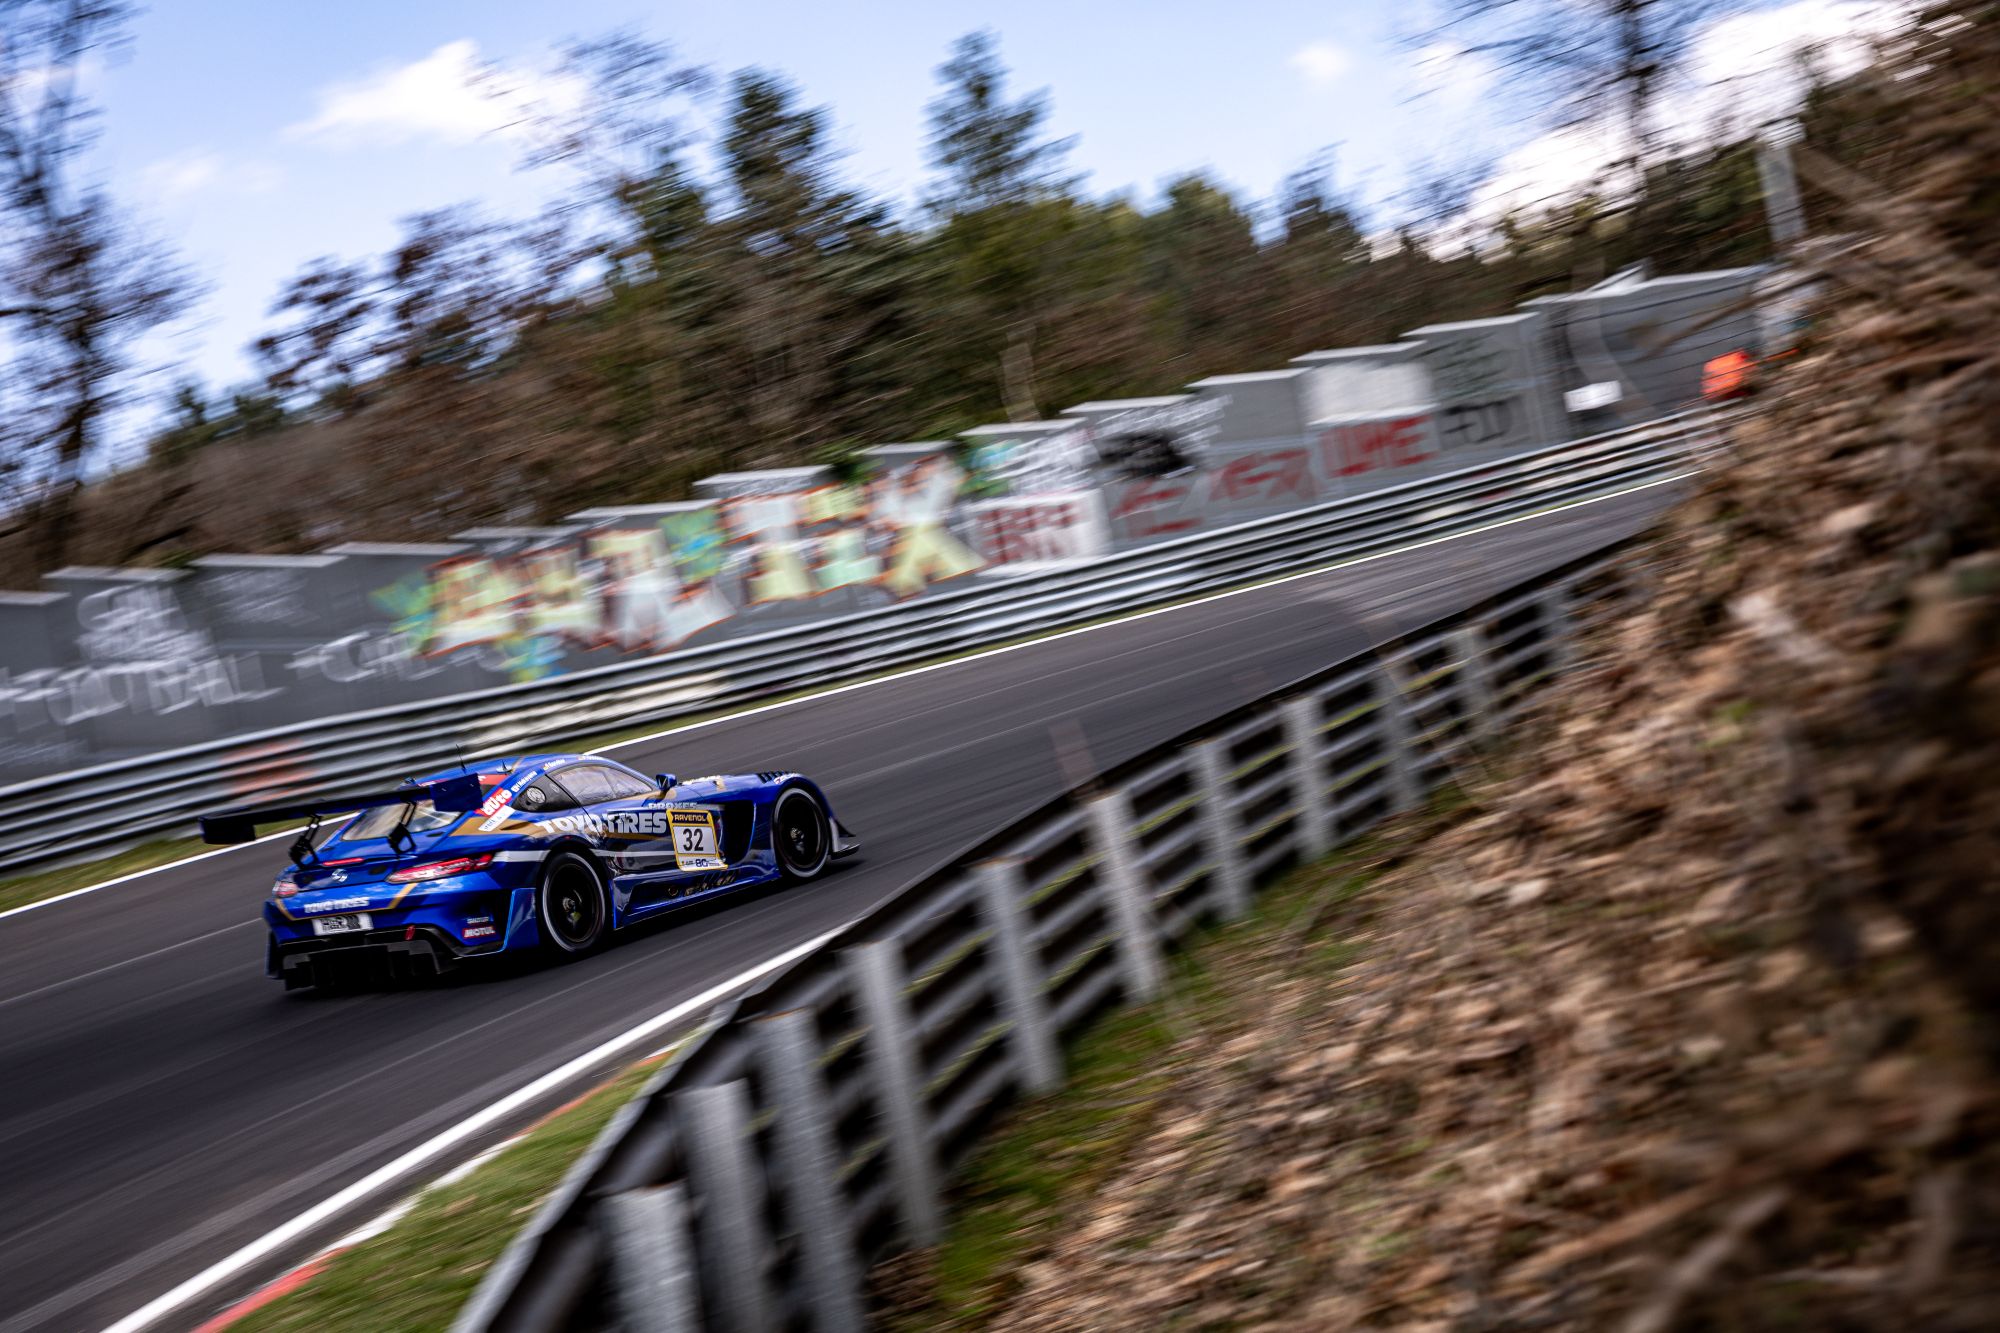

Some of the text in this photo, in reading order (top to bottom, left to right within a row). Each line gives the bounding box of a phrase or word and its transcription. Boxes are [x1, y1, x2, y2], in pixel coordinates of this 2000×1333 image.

[534, 813, 603, 835] TOYO
[603, 811, 667, 834] TIRES
[674, 814, 707, 822] RAVENOL
[683, 828, 704, 851] 32
[464, 927, 496, 938] MOTUL
